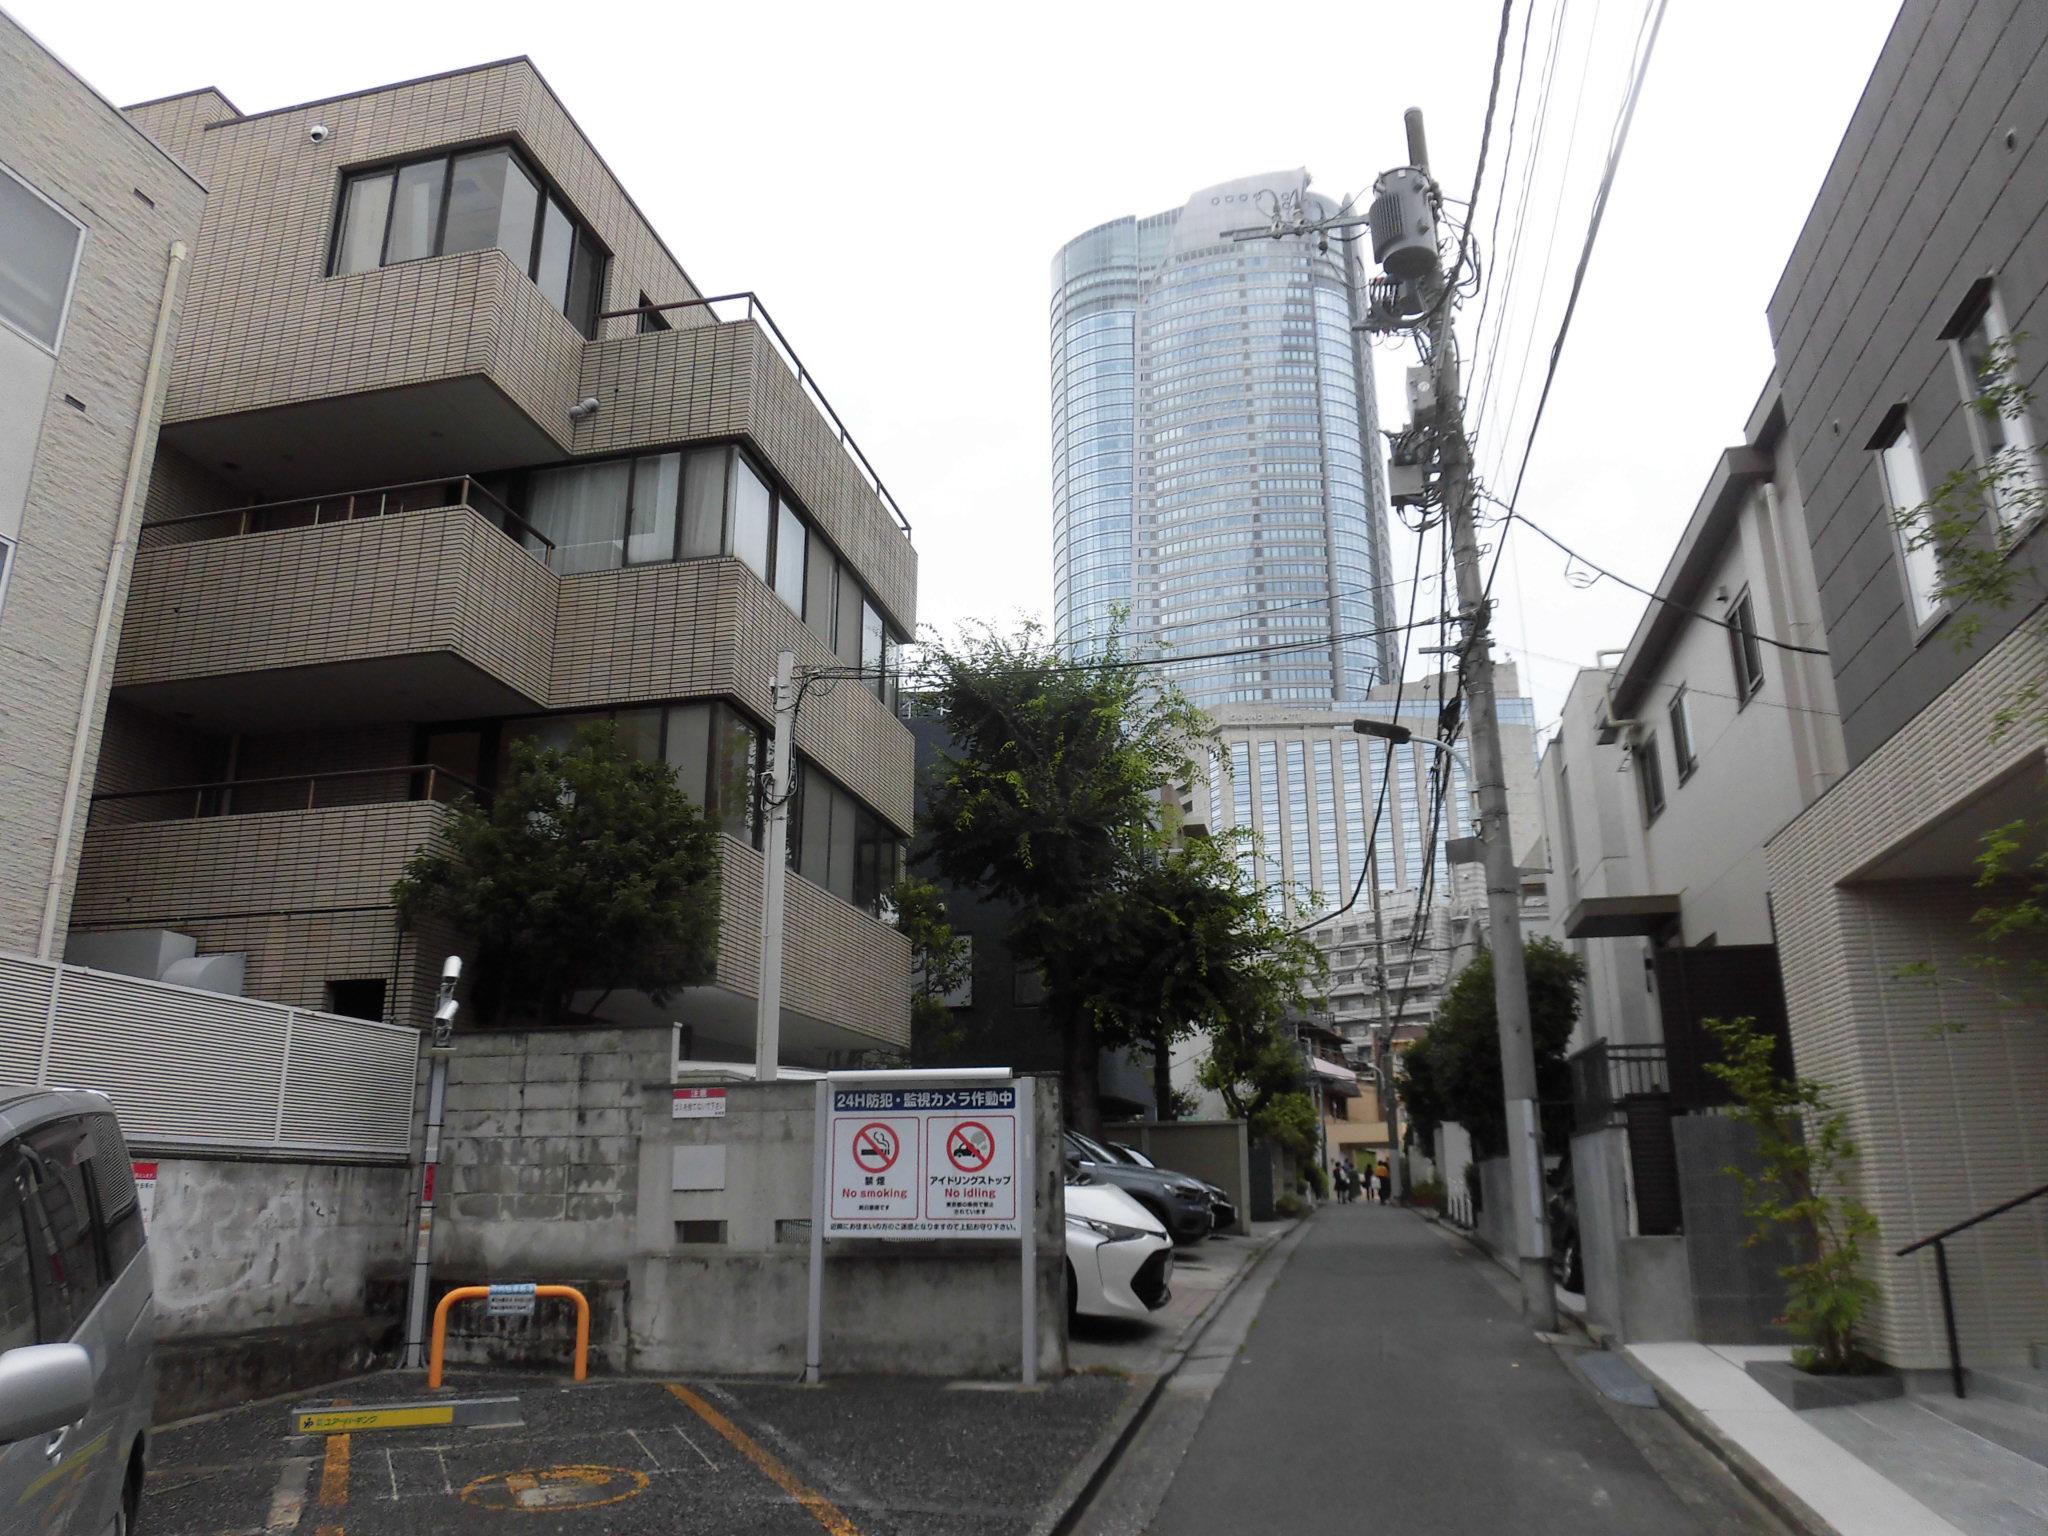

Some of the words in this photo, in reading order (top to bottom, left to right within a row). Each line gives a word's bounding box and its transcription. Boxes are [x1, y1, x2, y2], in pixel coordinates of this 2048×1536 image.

[836, 1091, 1013, 1108] 24H防犯・監視カメラ作動中
[865, 1176, 885, 1186] 禁煙
[930, 1176, 1011, 1186] アイドリングストップ
[842, 1188, 857, 1198] No
[860, 1188, 908, 1200] smoking
[945, 1188, 960, 1198] No
[963, 1188, 996, 1199] idling
